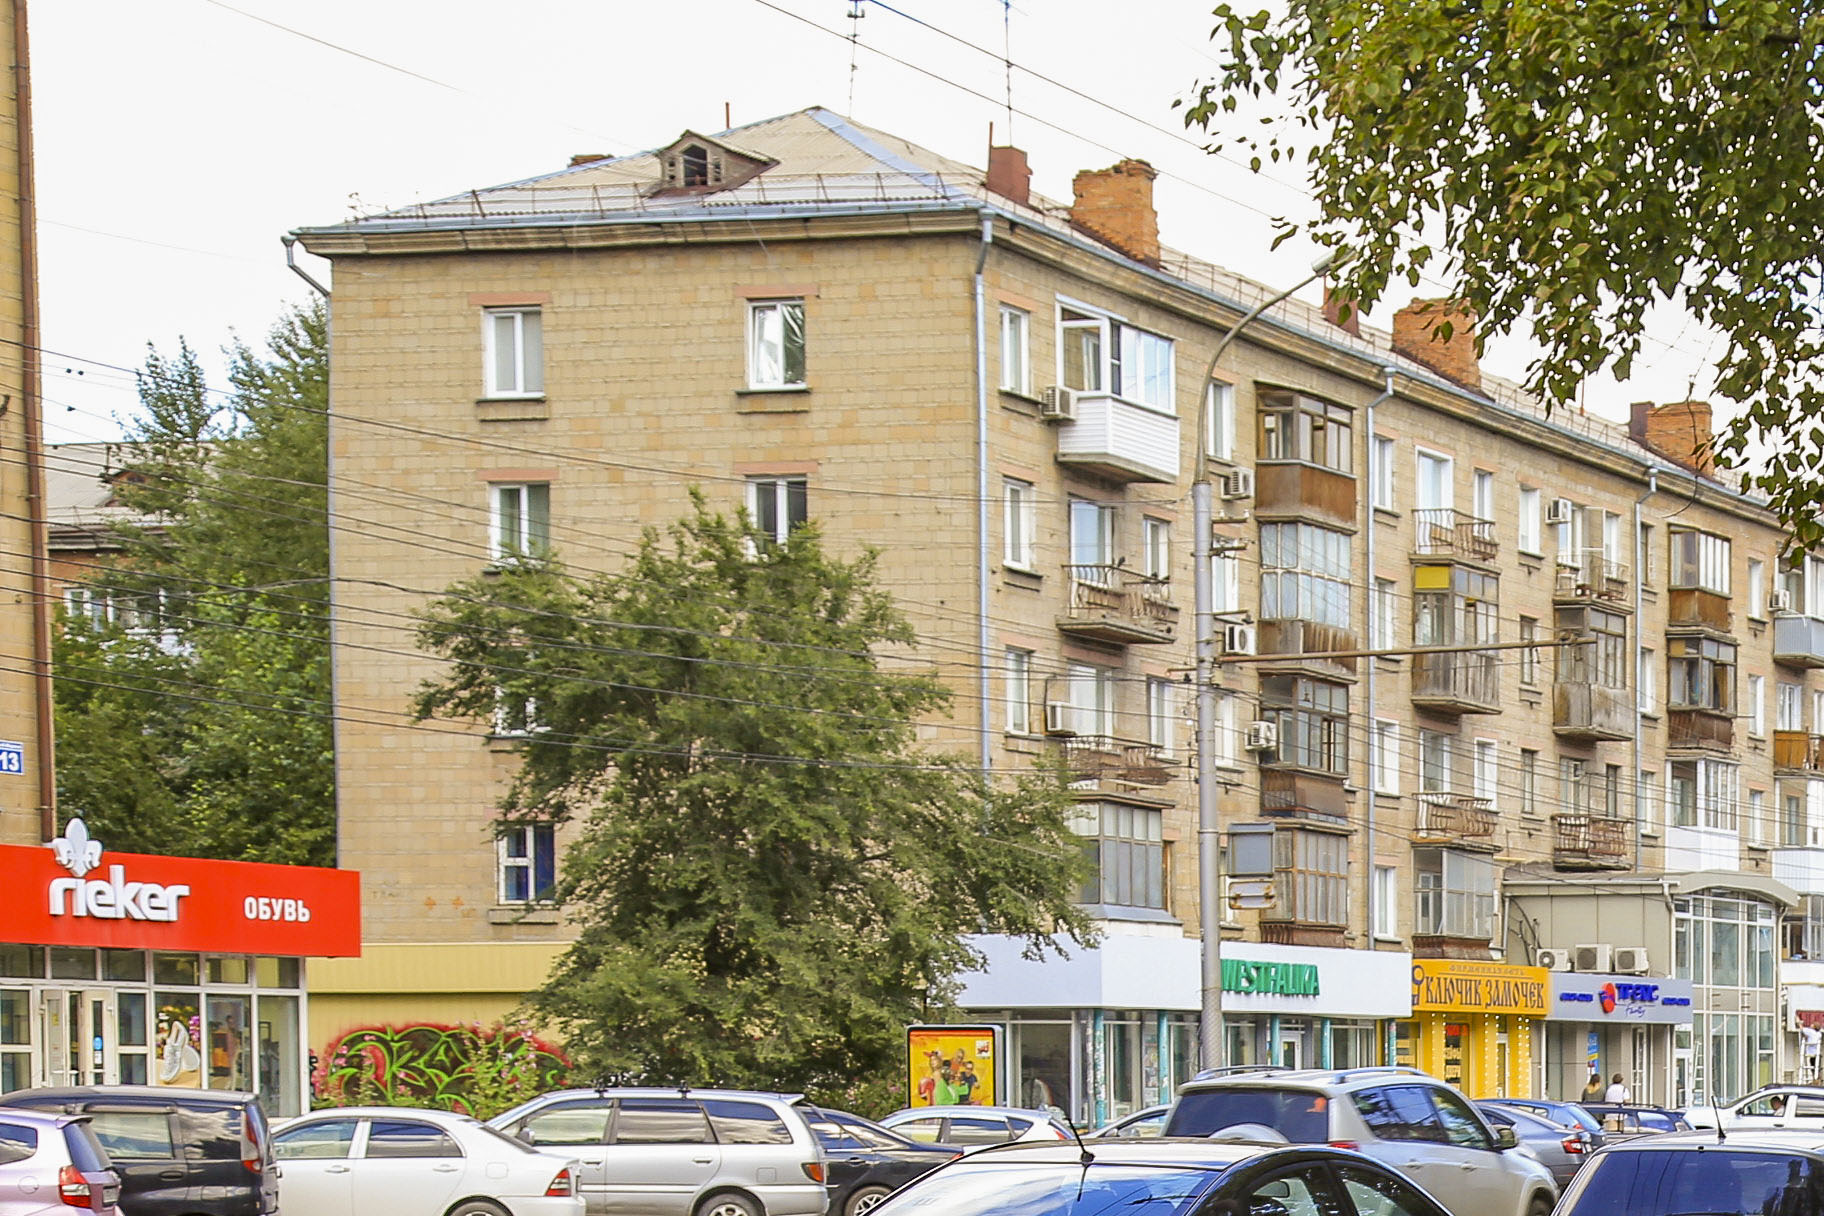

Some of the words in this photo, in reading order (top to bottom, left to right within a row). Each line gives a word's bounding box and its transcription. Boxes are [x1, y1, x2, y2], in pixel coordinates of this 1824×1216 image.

[0, 752, 19, 771] 13
[49, 864, 190, 922] rieker
[244, 896, 311, 922] ОБУВЬ
[1220, 958, 1320, 996] WESTFALIKA
[1425, 976, 1482, 1006] КЛЮЧИК
[1485, 979, 1545, 1009] ЗАМОЧЕК
